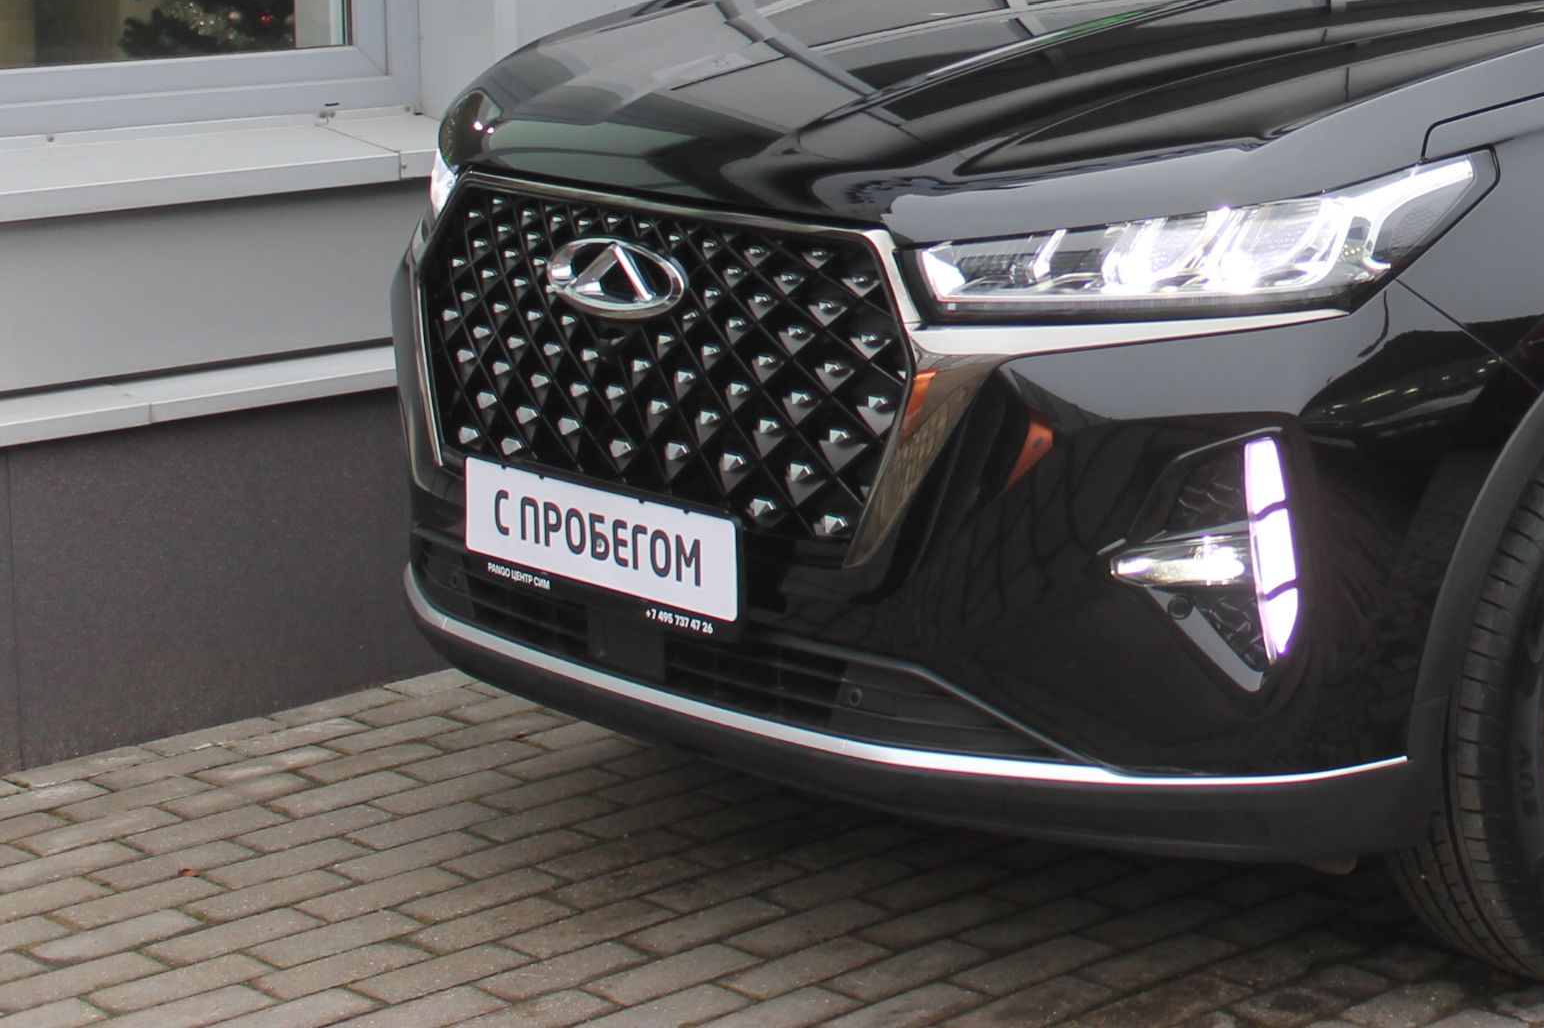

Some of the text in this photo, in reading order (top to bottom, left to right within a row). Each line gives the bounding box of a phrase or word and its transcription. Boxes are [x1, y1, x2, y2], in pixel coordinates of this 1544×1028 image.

[494, 489, 702, 587] С ПРОБЕГОМ
[487, 562, 551, 590] PANGO ЦЕНТР СИМ
[645, 608, 657, 620] +7
[658, 611, 674, 624] 495
[674, 614, 690, 628] 737
[702, 621, 714, 634] 26
